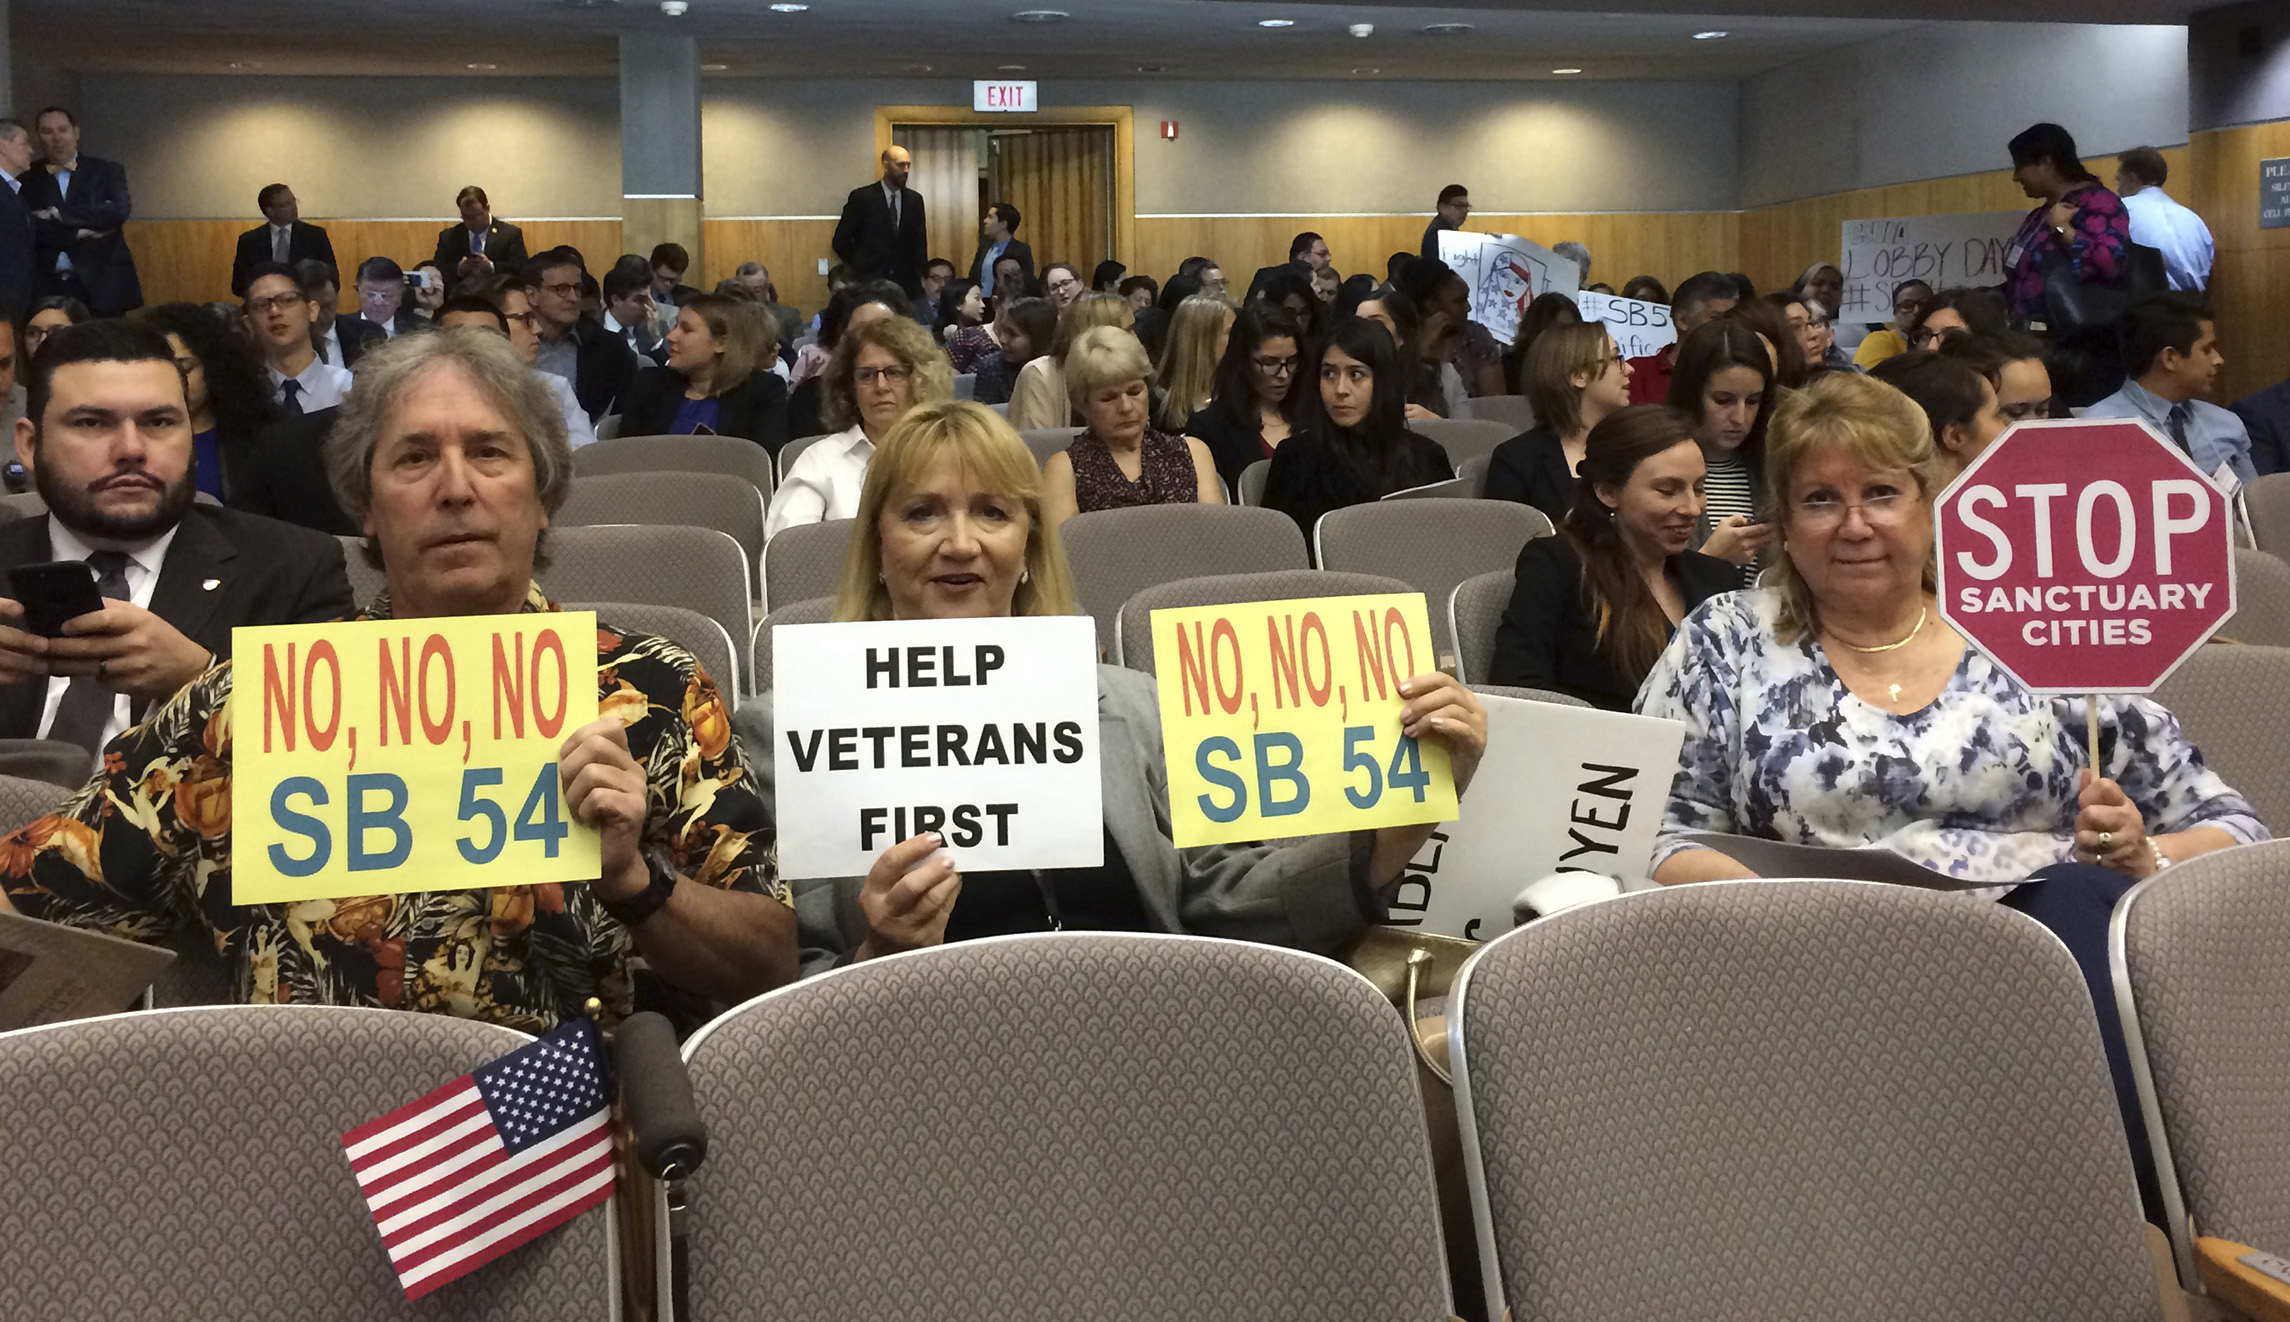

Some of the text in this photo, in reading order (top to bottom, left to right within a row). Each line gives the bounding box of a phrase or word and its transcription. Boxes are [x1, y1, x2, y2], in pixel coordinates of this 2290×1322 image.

[987, 86, 1023, 107] EXIT
[2265, 165, 2290, 177] PLE
[1442, 246, 1478, 268] Fight
[1847, 237, 2013, 280] LOBBY DAY
[1582, 296, 1671, 328] #SB5
[1615, 334, 1663, 357] ific
[1957, 479, 2211, 581] STOP
[1961, 583, 2213, 613] SANCTUARY
[2022, 618, 2152, 647] CITIES
[866, 645, 1005, 689] HELP
[1176, 607, 1415, 731] NO, NO, NO
[263, 628, 568, 771] NO, NO, NO
[786, 721, 1084, 772] VETERANS
[1195, 725, 1431, 824] SB 54
[267, 762, 568, 878] SB 54
[860, 803, 1018, 851] FIRST
[1555, 763, 1640, 874] YEN
